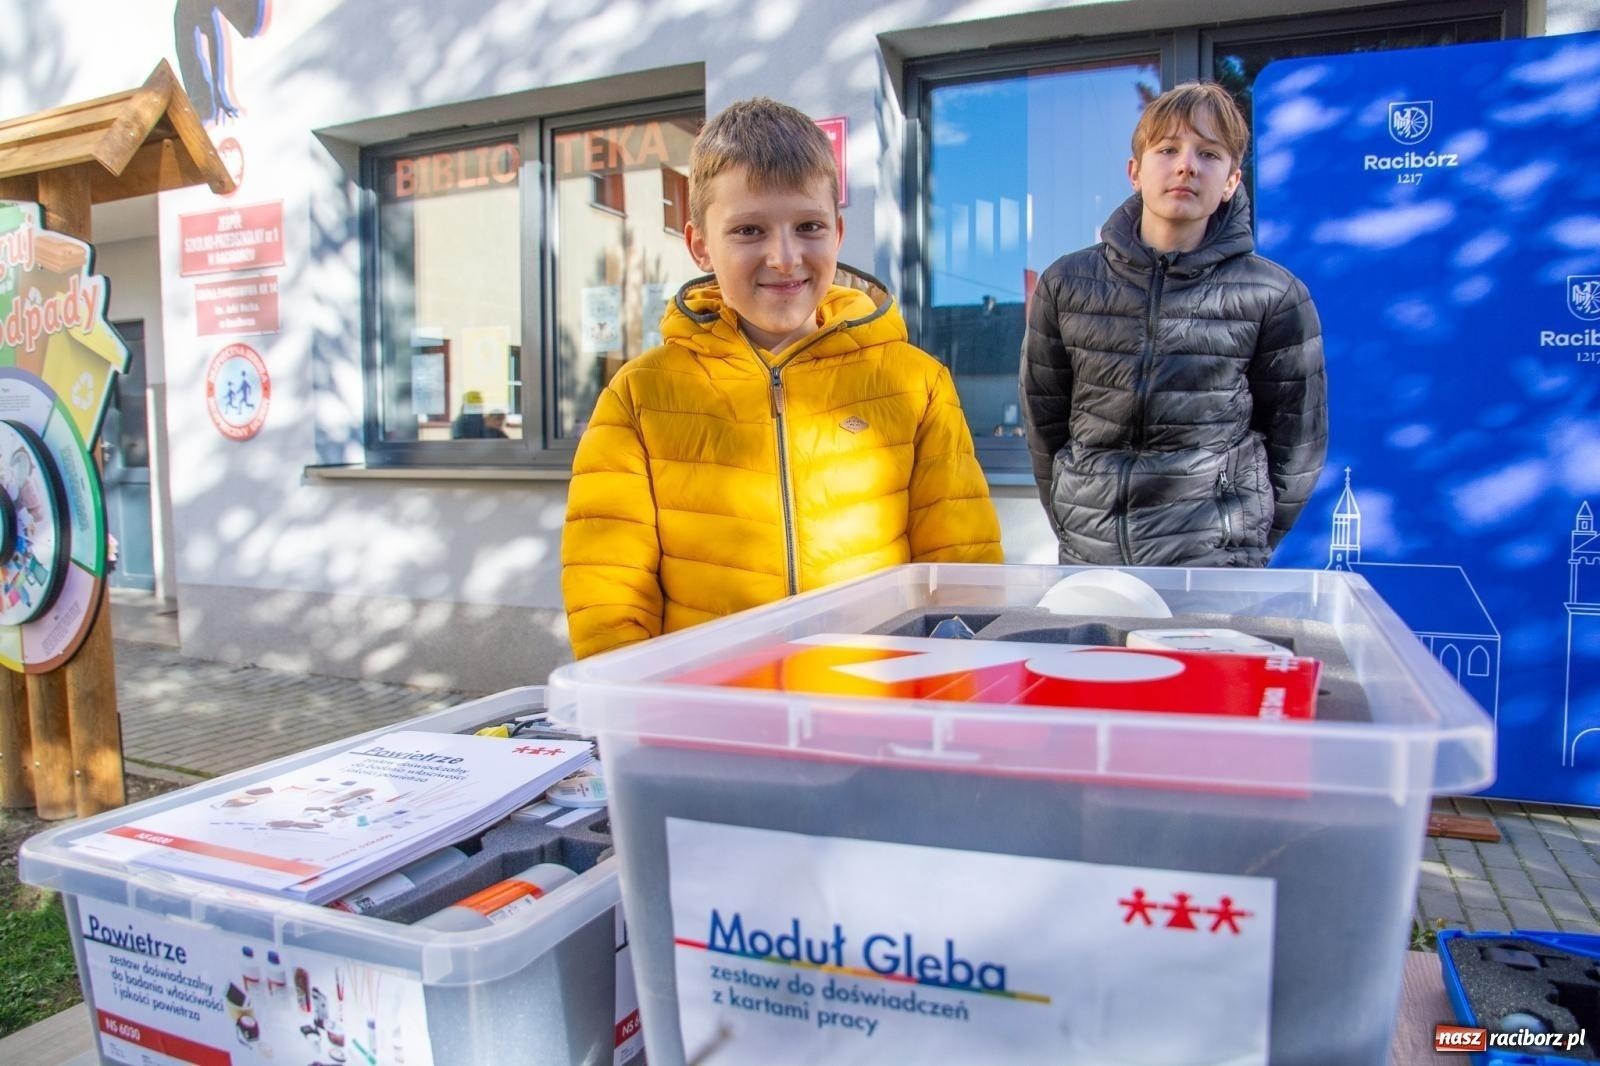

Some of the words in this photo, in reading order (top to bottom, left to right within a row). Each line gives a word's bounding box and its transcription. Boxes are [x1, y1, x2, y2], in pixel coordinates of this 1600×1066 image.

[396, 142, 521, 198] BIBLIO
[554, 121, 670, 175] TEKA
[1364, 151, 1458, 170] Racibórz
[1397, 172, 1423, 185] 1217
[362, 745, 464, 765] Powietrze
[89, 914, 188, 965] Powietrze
[708, 908, 846, 967] Moduł
[863, 933, 1007, 992] Gleba
[109, 955, 140, 971] zestaw
[143, 960, 213, 996] doświadczalny
[112, 967, 124, 982] do
[125, 970, 164, 994] badania
[166, 988, 225, 1012] właściwości
[710, 965, 780, 991] zestaw
[787, 972, 815, 998] do
[822, 977, 970, 1022] doświadczeń
[119, 984, 151, 1006] jakości
[152, 998, 201, 1021] powietrza
[712, 991, 723, 1004] z
[729, 987, 809, 1021] kartami
[817, 1010, 878, 1037] pracy
[105, 1017, 118, 1033] NS
[119, 1024, 141, 1041] 6030
